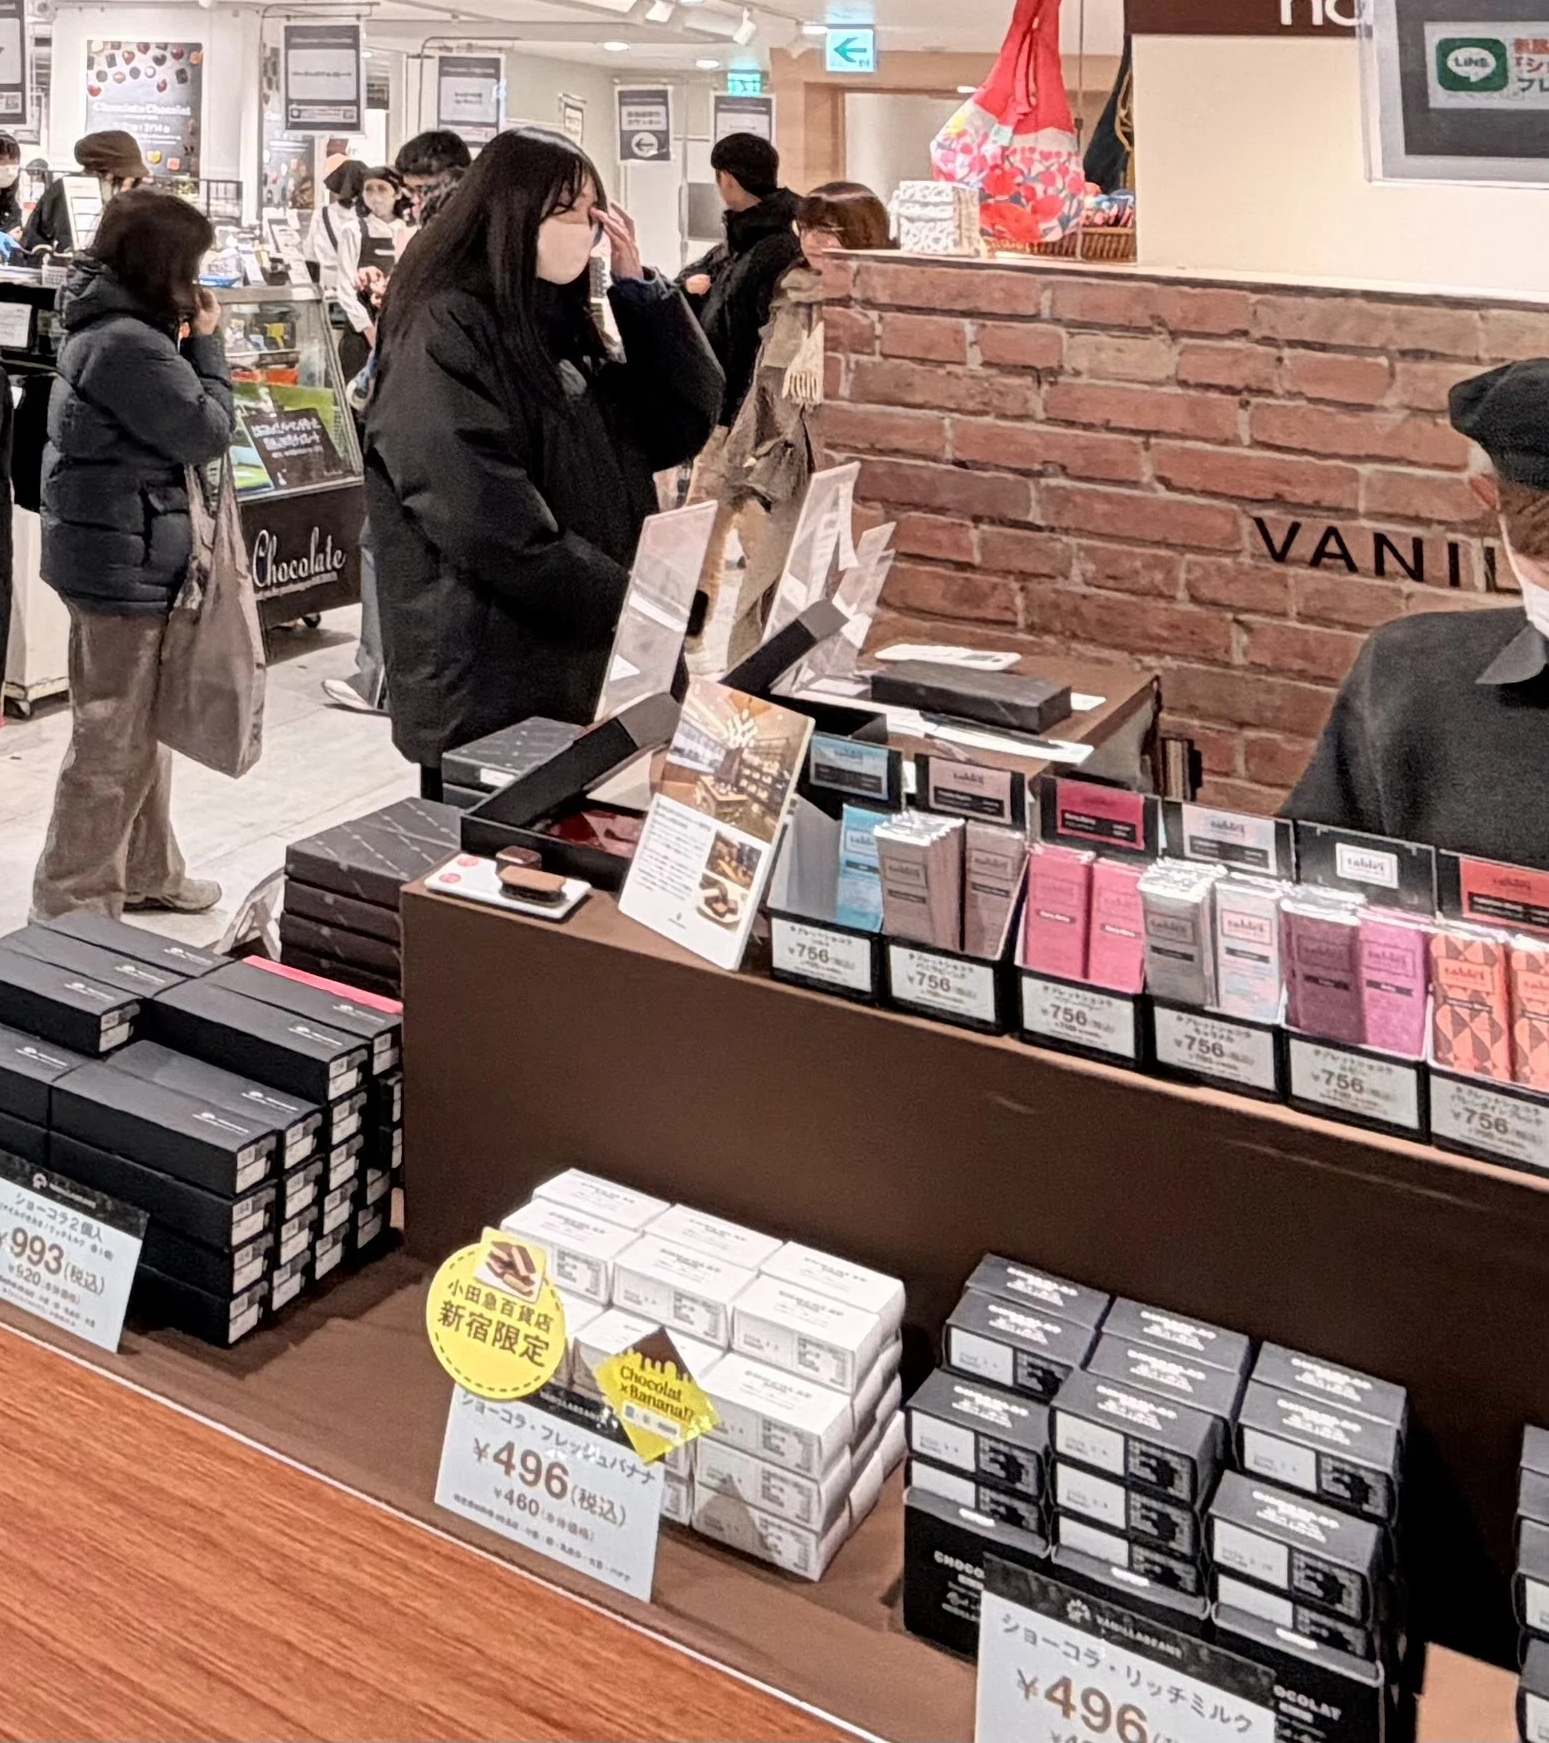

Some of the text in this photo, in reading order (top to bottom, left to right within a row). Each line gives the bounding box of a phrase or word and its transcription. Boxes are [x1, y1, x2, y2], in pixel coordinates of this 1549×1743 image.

[253, 526, 347, 588] Chocolate
[438, 1299, 550, 1368] 新宿限定
[448, 1278, 554, 1335] 小田急百貨店
[620, 1365, 683, 1402] Chocolat
[473, 1438, 570, 1500] ¥496
[494, 1487, 540, 1517] ¥460
[571, 1484, 627, 1528] (税込)
[934, 1550, 985, 1578] CHOCO
[1002, 1613, 1253, 1734] ショーコラ・リッチミルク
[1017, 1668, 1148, 1743] ¥496
